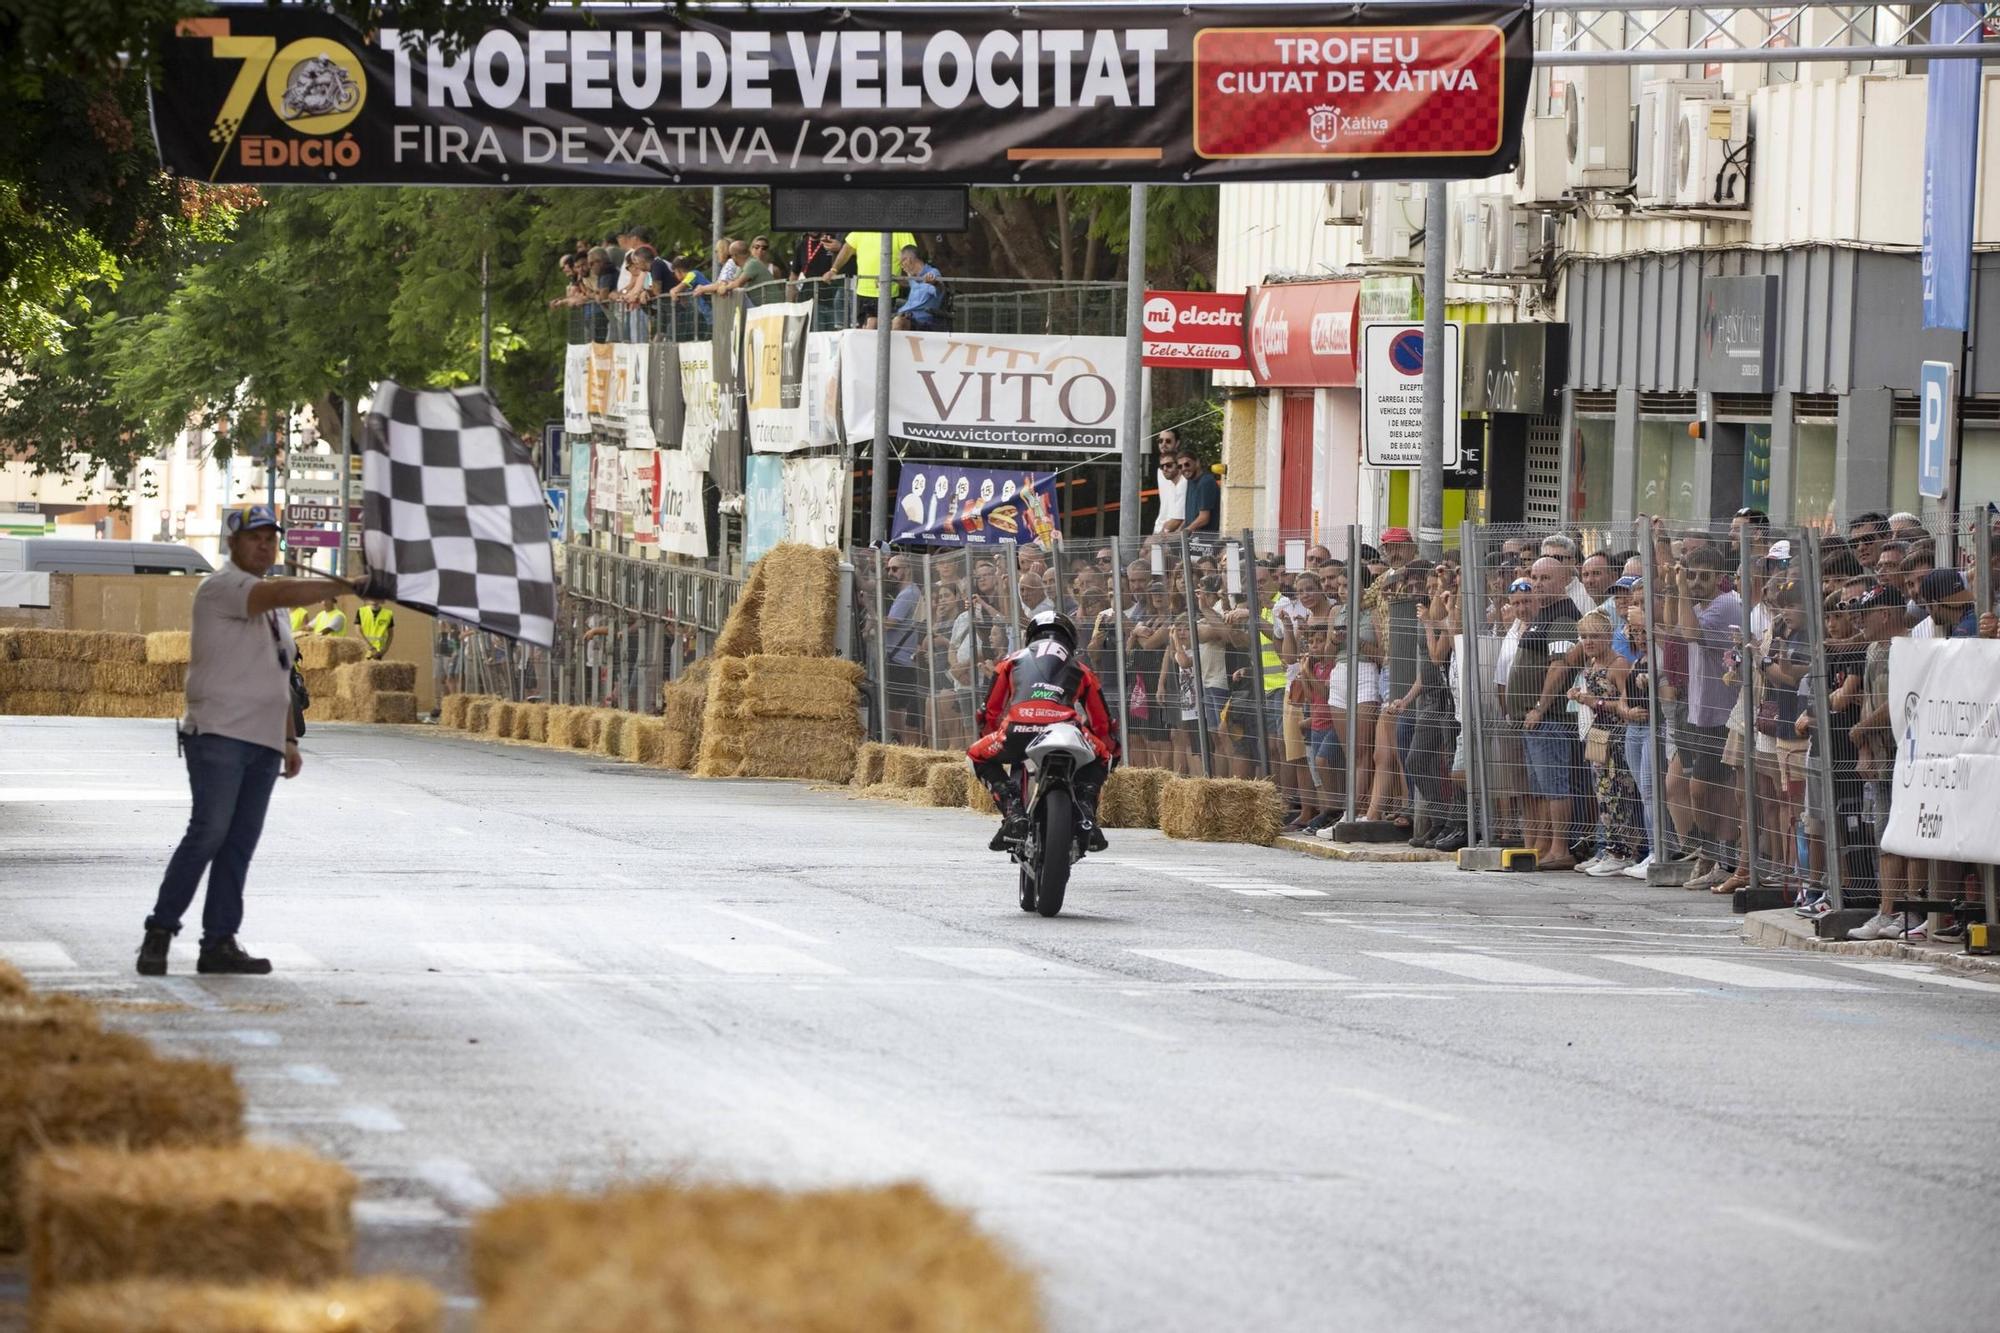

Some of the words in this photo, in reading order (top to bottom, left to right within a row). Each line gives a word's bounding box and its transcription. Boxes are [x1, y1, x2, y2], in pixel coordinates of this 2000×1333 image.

[1274, 37, 1419, 65] TROFEU
[381, 28, 662, 110] TROFEU
[681, 31, 772, 109] DE
[787, 29, 1168, 109] VELOCITAT
[1216, 71, 1319, 94] CIUTAT
[1326, 71, 1365, 93] DE
[1373, 62, 1479, 92] XÀTIVA
[209, 37, 368, 150] 70
[1340, 116, 1388, 130] Xàtiva
[240, 132, 361, 167] EDICIÓ
[394, 125, 506, 164] FIRA
[523, 125, 588, 164] DE
[604, 117, 778, 165] XÀTIVA
[789, 120, 811, 169] /
[821, 126, 933, 166] 2023
[1148, 308, 1170, 322] mi
[1150, 344, 1230, 358] Tele-Xàtiva
[916, 370, 1117, 426] VITO
[907, 426, 1112, 445] www.victortormo.com
[1925, 381, 1942, 478] P
[291, 462, 336, 470] TAVERNES
[290, 487, 340, 496] ajuntament
[291, 507, 326, 520] UNED
[1036, 641, 1069, 662] 16
